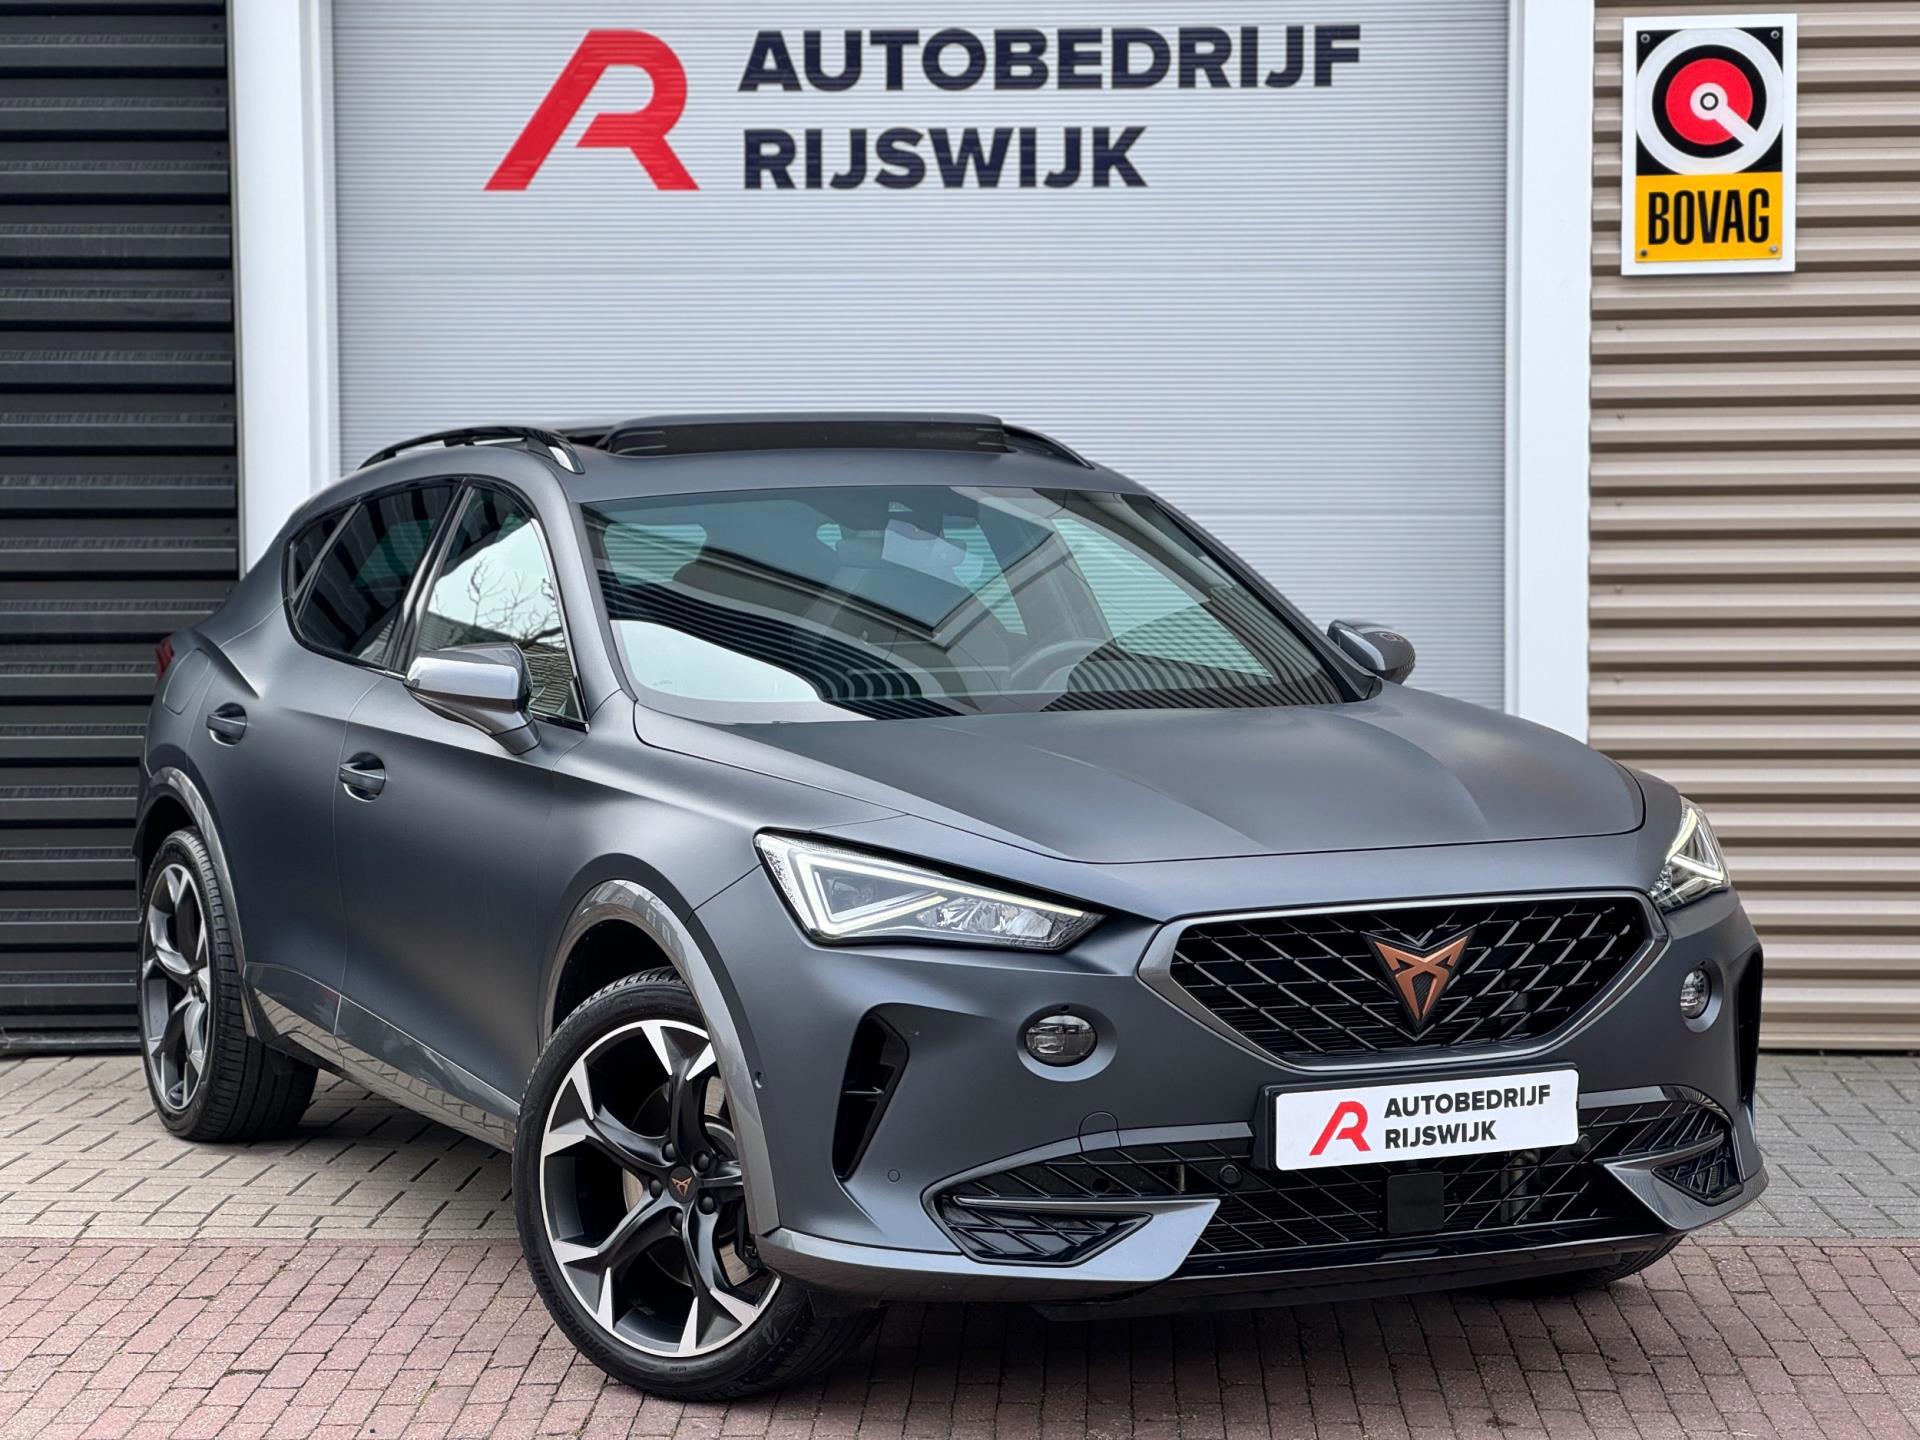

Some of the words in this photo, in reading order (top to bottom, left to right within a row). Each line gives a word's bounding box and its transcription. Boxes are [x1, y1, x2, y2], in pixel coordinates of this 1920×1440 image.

[738, 25, 1361, 92] AUTOBEDRIJF
[744, 127, 1148, 190] RIJSWIJK
[1648, 188, 1770, 246] BOVAG
[1384, 1084, 1551, 1119] AUTOBEDRIJF
[1385, 1120, 1497, 1150] RIJSWIJK
